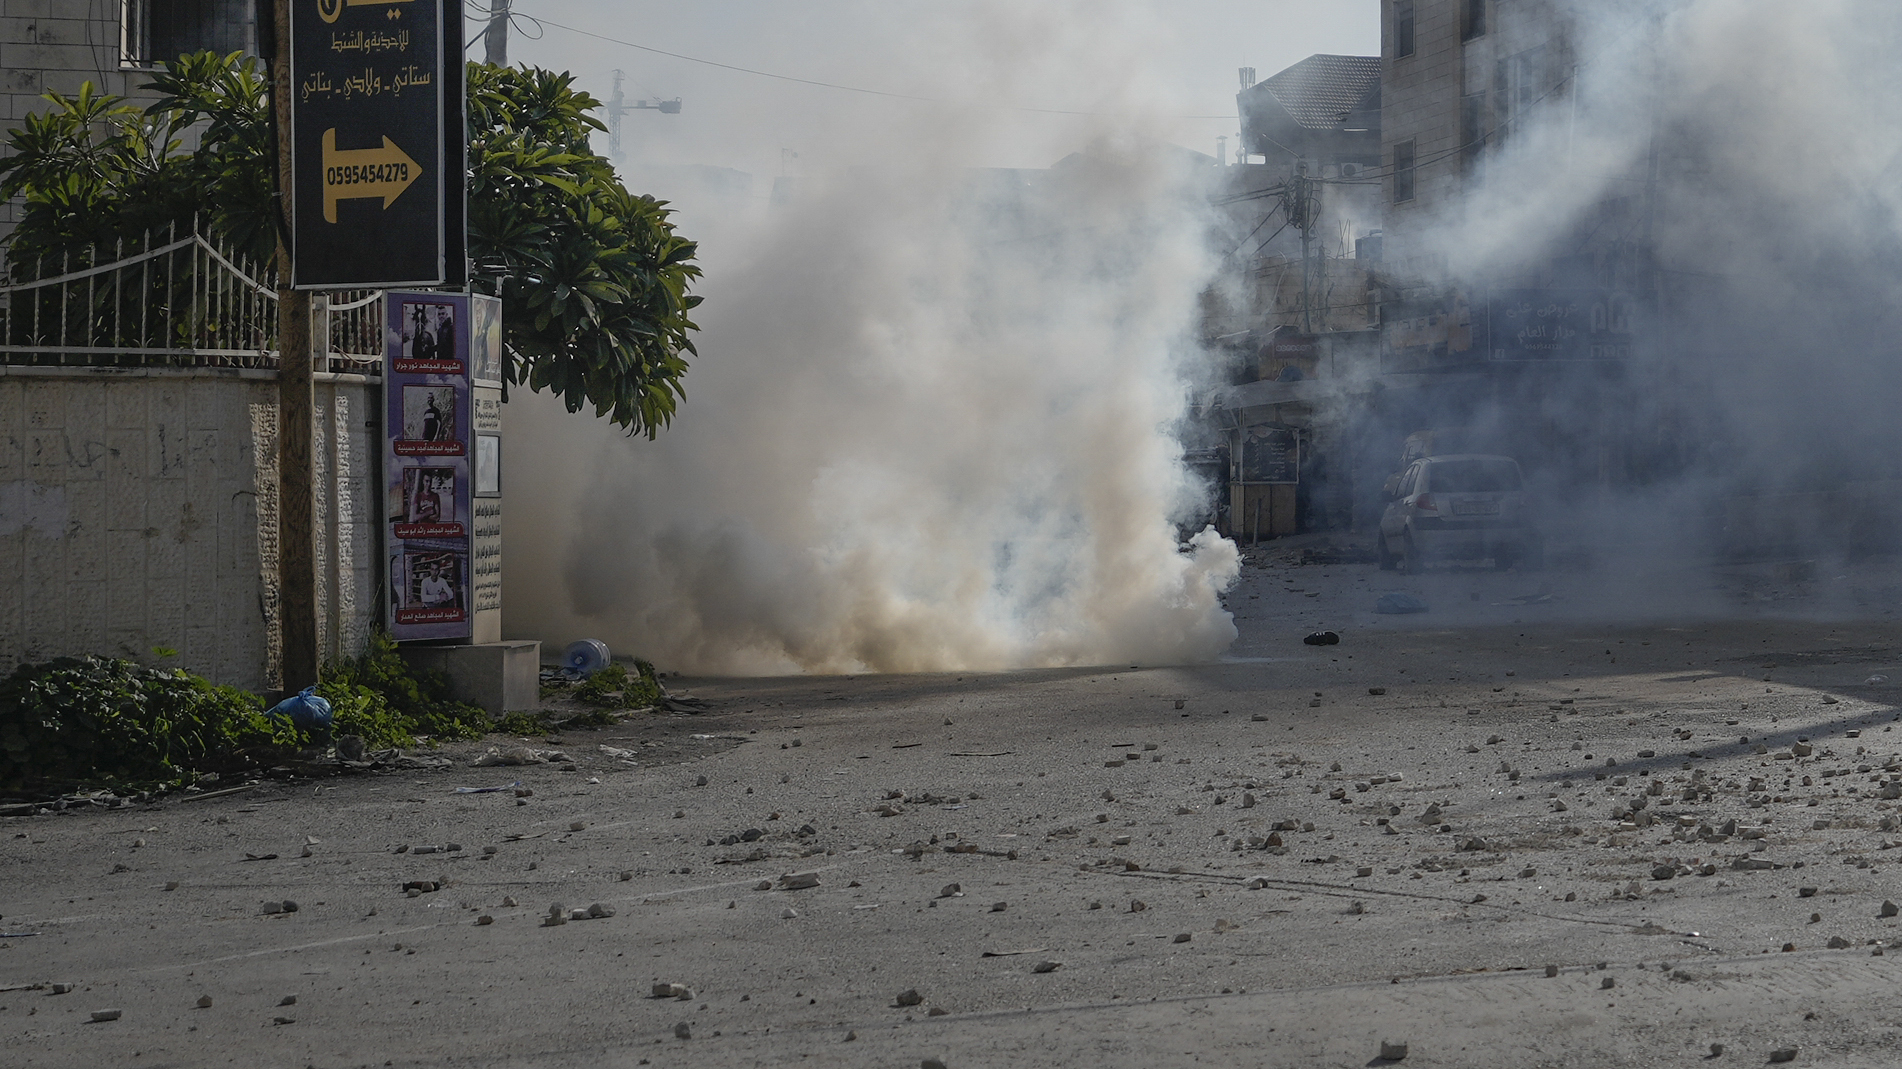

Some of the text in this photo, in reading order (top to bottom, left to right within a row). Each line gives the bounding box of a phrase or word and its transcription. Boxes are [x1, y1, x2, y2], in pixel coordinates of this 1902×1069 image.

[301, 71, 332, 103] بناتي
[344, 67, 381, 100] ولادي
[327, 162, 408, 186] 0595454279
